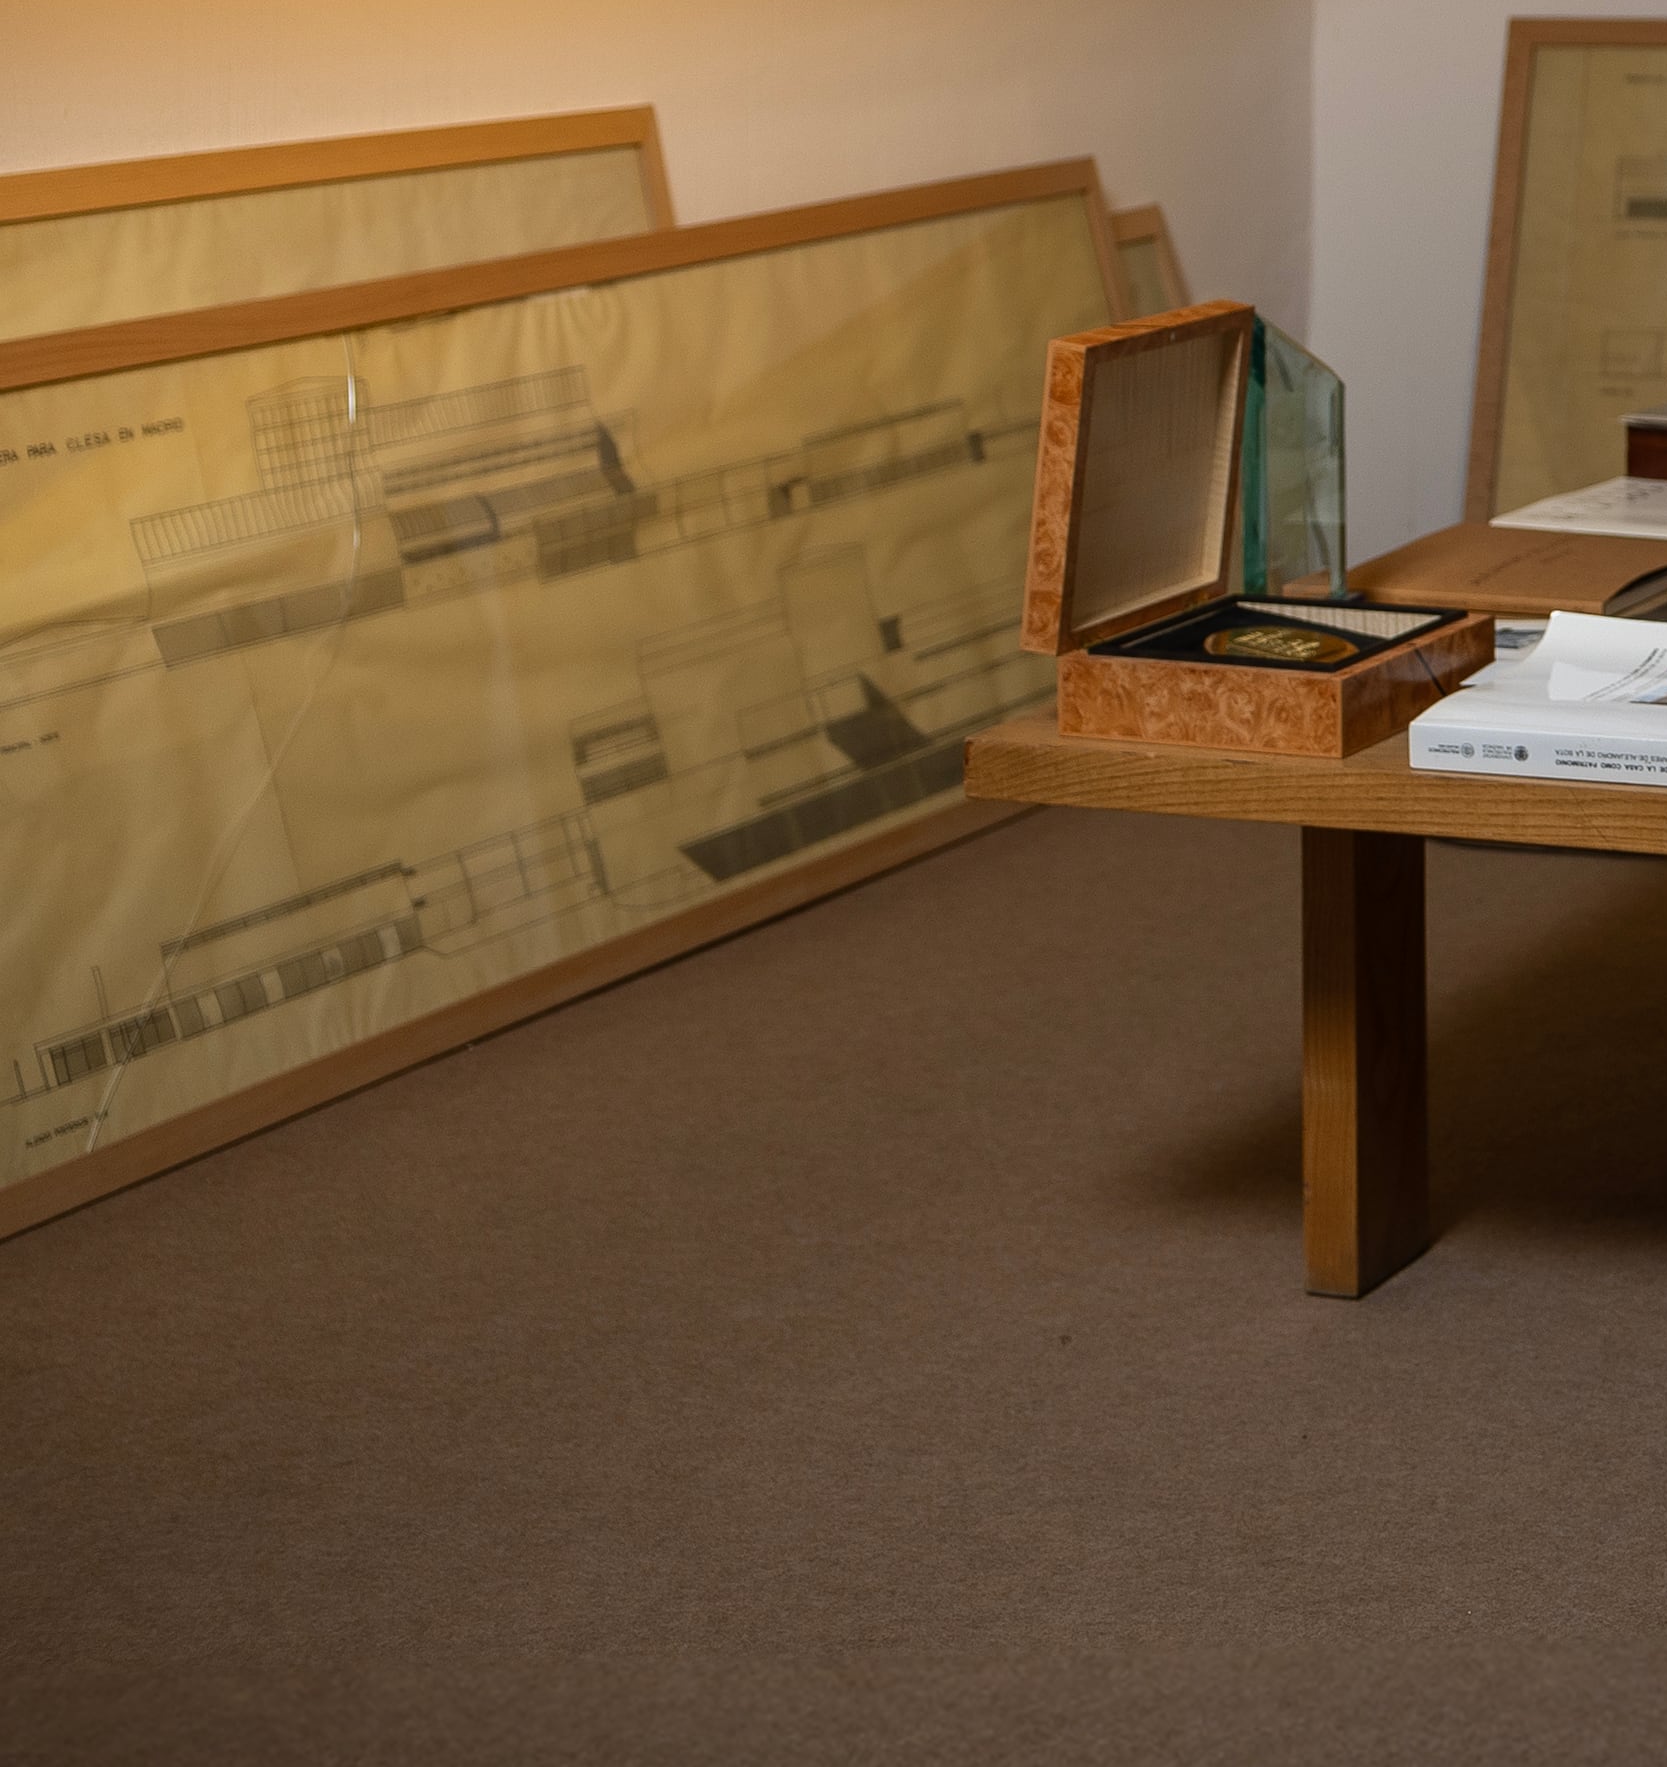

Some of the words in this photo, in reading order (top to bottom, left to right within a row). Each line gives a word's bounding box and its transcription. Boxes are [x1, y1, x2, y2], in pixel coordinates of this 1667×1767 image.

[26, 442, 57, 459] PARA
[65, 431, 111, 452] CLESA
[118, 426, 135, 443] EN
[141, 417, 184, 437] MADRID
[1554, 748, 1574, 757] SOTA
[1585, 750, 1596, 758] DE
[1597, 751, 1637, 761] ALEJANDRO
[1555, 758, 1598, 768] PATRIMONIO
[1599, 761, 1622, 770] COMO
[1624, 763, 1644, 772] CASA
[1646, 765, 1656, 773] LA
